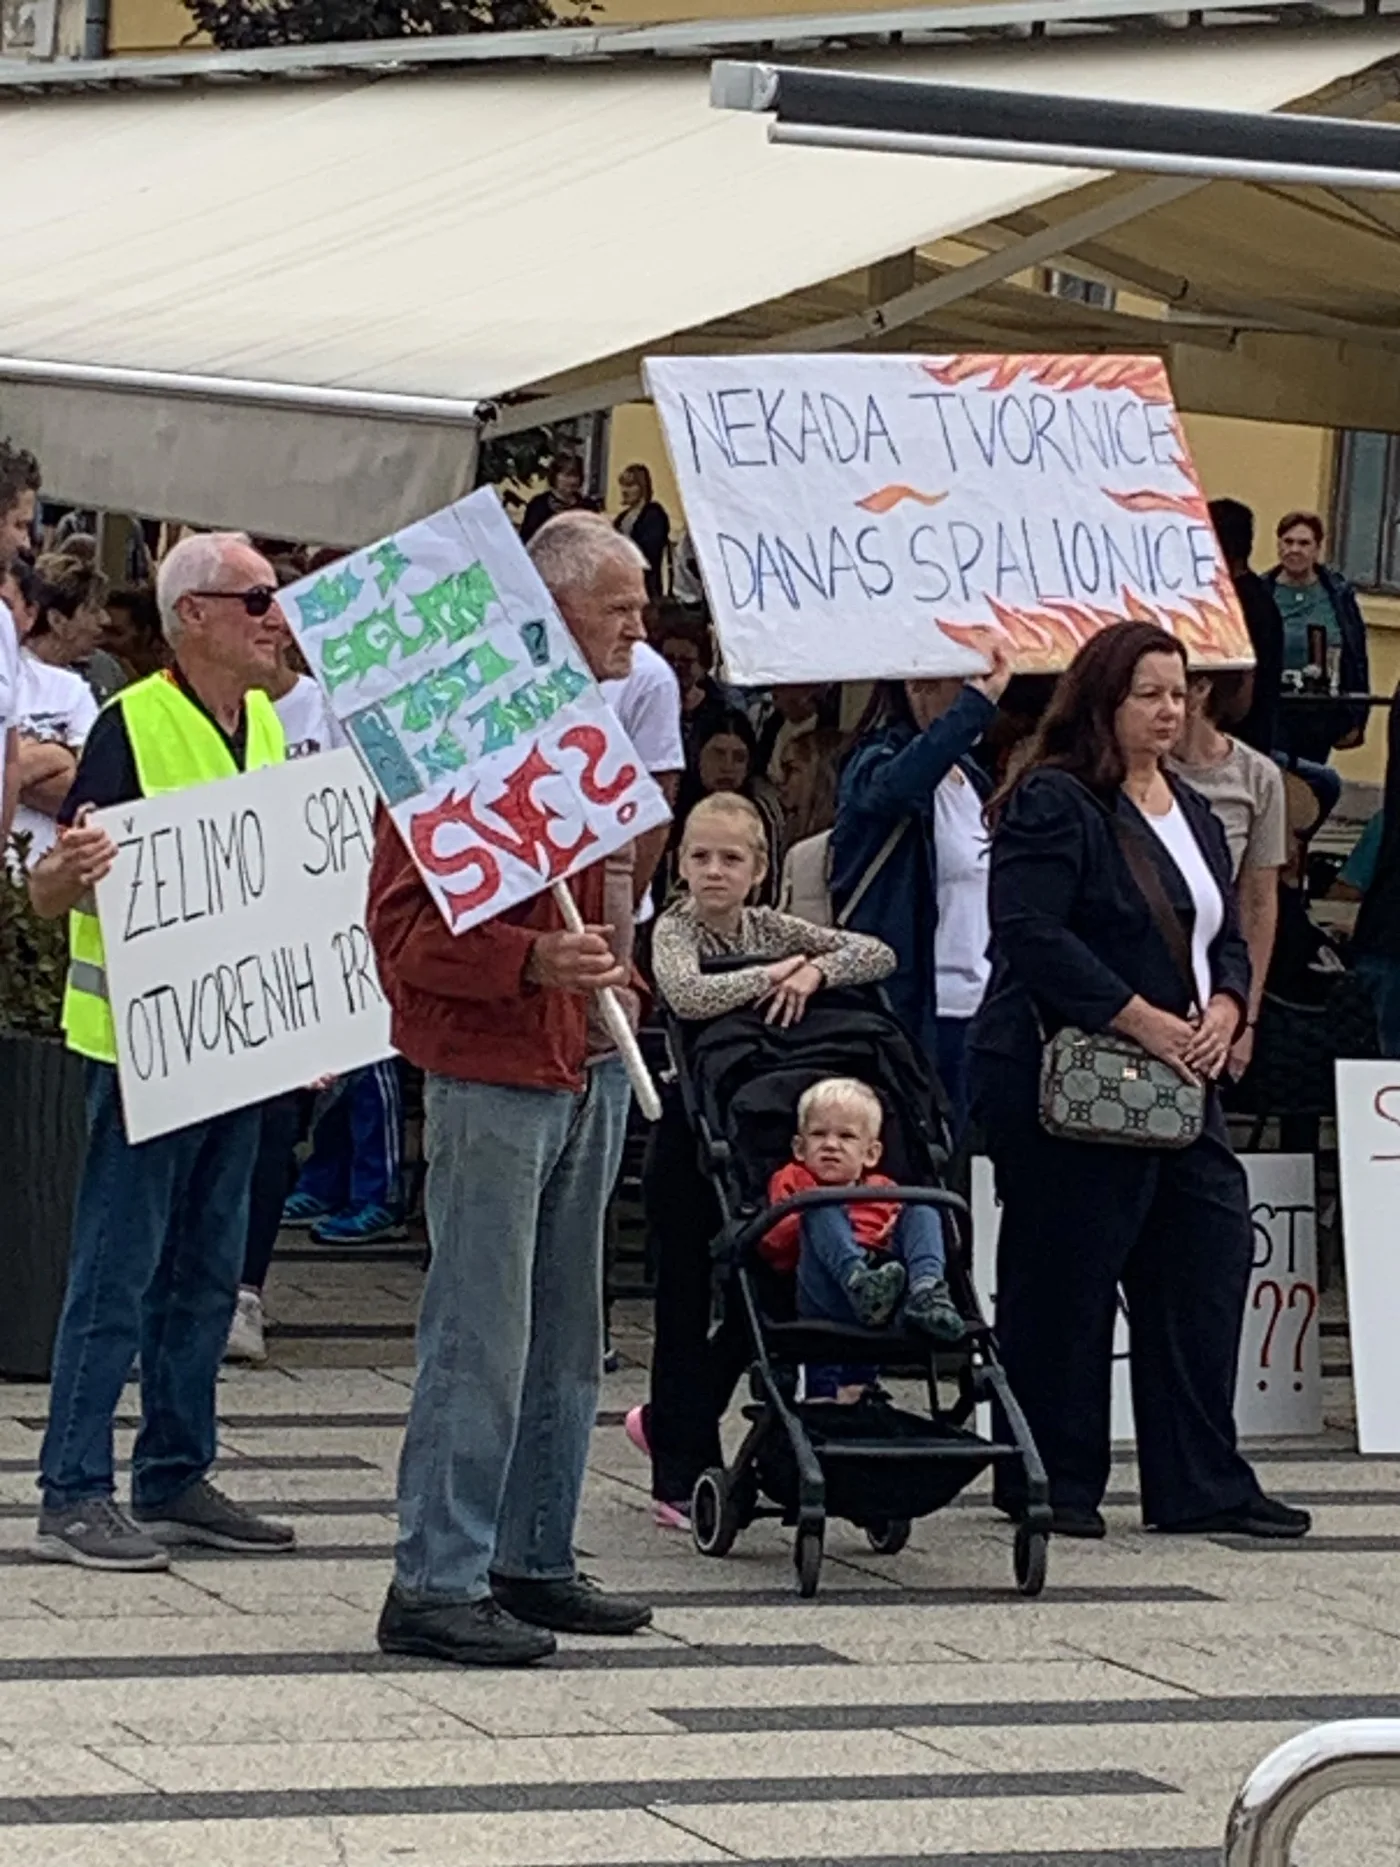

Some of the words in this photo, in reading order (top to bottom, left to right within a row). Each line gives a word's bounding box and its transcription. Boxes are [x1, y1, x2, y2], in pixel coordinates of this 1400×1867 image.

[679, 387, 901, 473] NEKADA
[908, 393, 1177, 475] TVORNICE
[318, 559, 499, 696] SIGURNO
[716, 525, 895, 611] DANAS
[908, 518, 1218, 601] SPALIONICE
[118, 809, 266, 942] ŽELIMO
[410, 724, 637, 926] SVE?
[127, 942, 321, 1081] OTVORENIH
